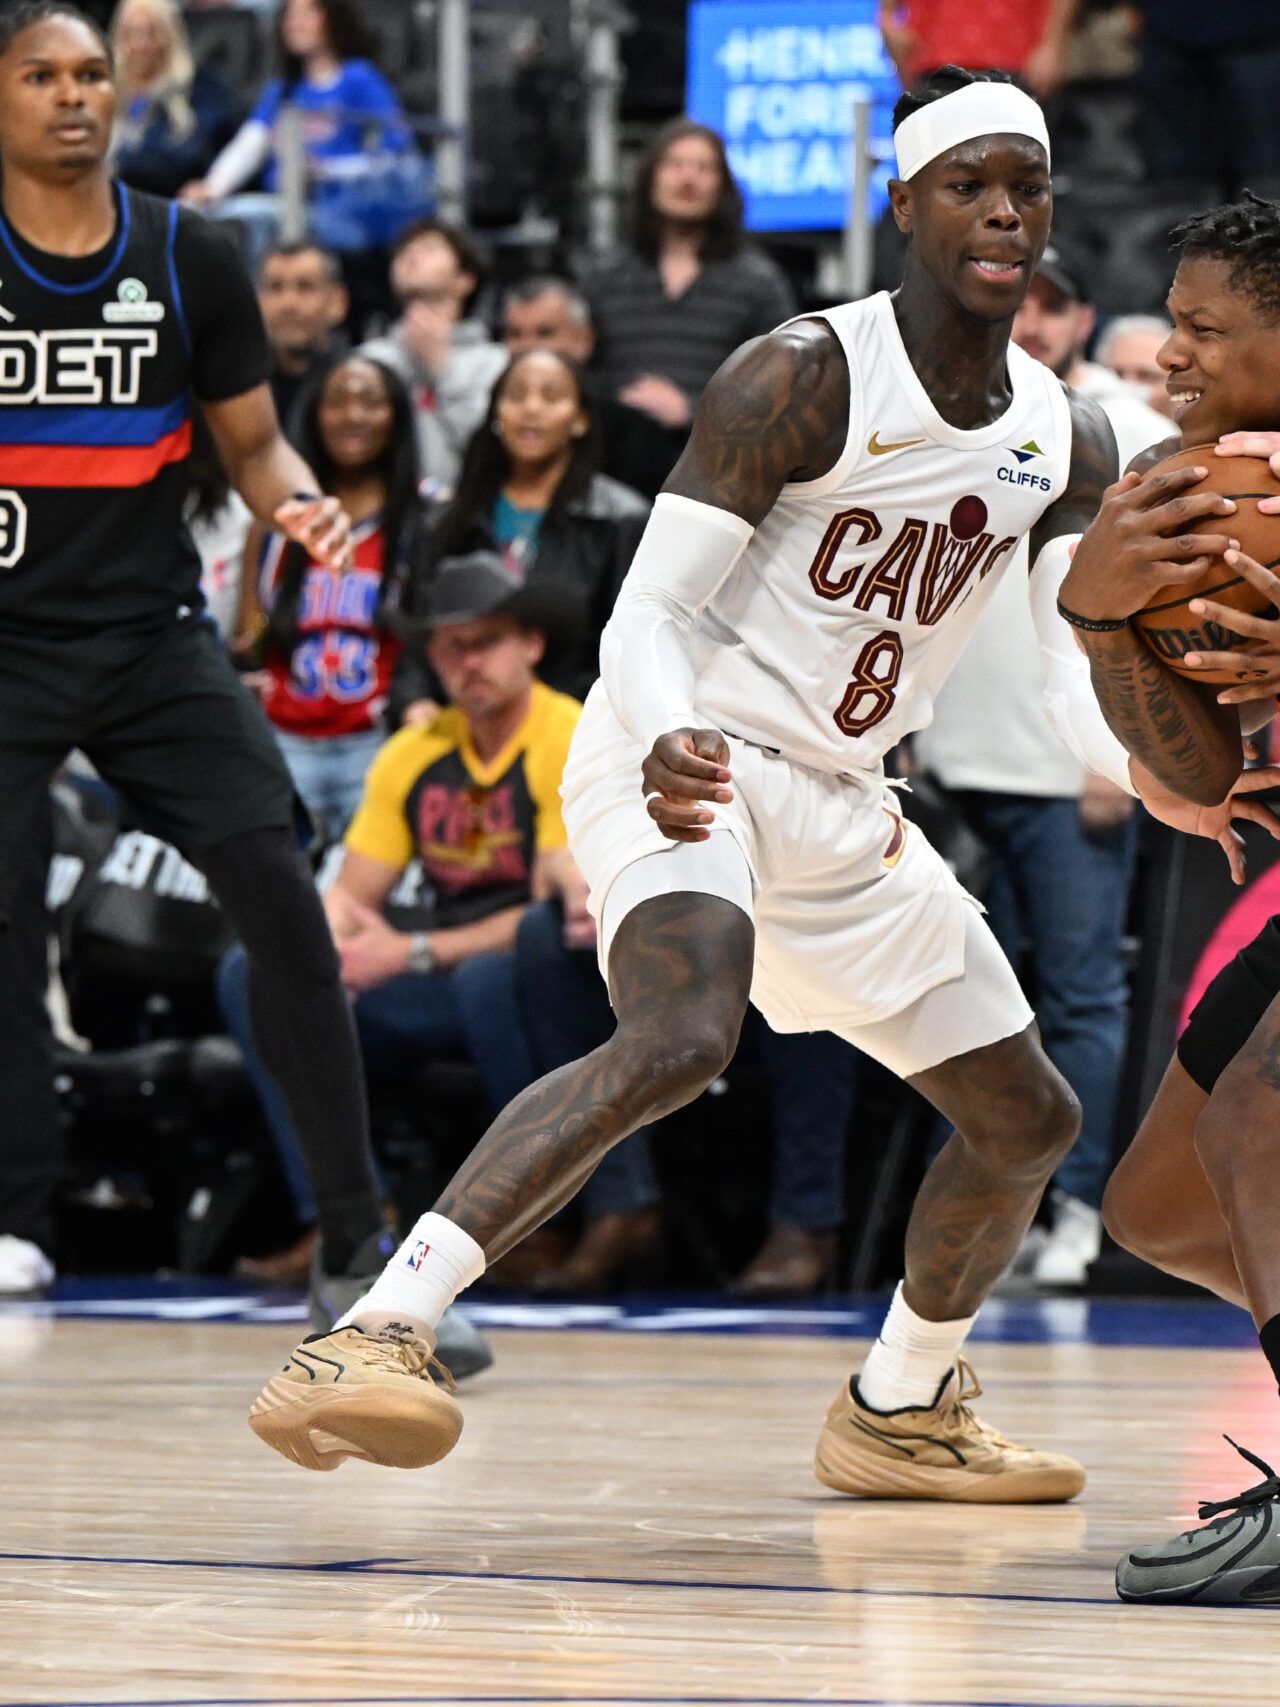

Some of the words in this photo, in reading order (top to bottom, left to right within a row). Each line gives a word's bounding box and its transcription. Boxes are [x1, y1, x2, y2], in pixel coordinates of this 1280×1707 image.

[0, 328, 158, 404] DET
[997, 466, 1051, 491] CLIFFS
[833, 629, 903, 738] 8
